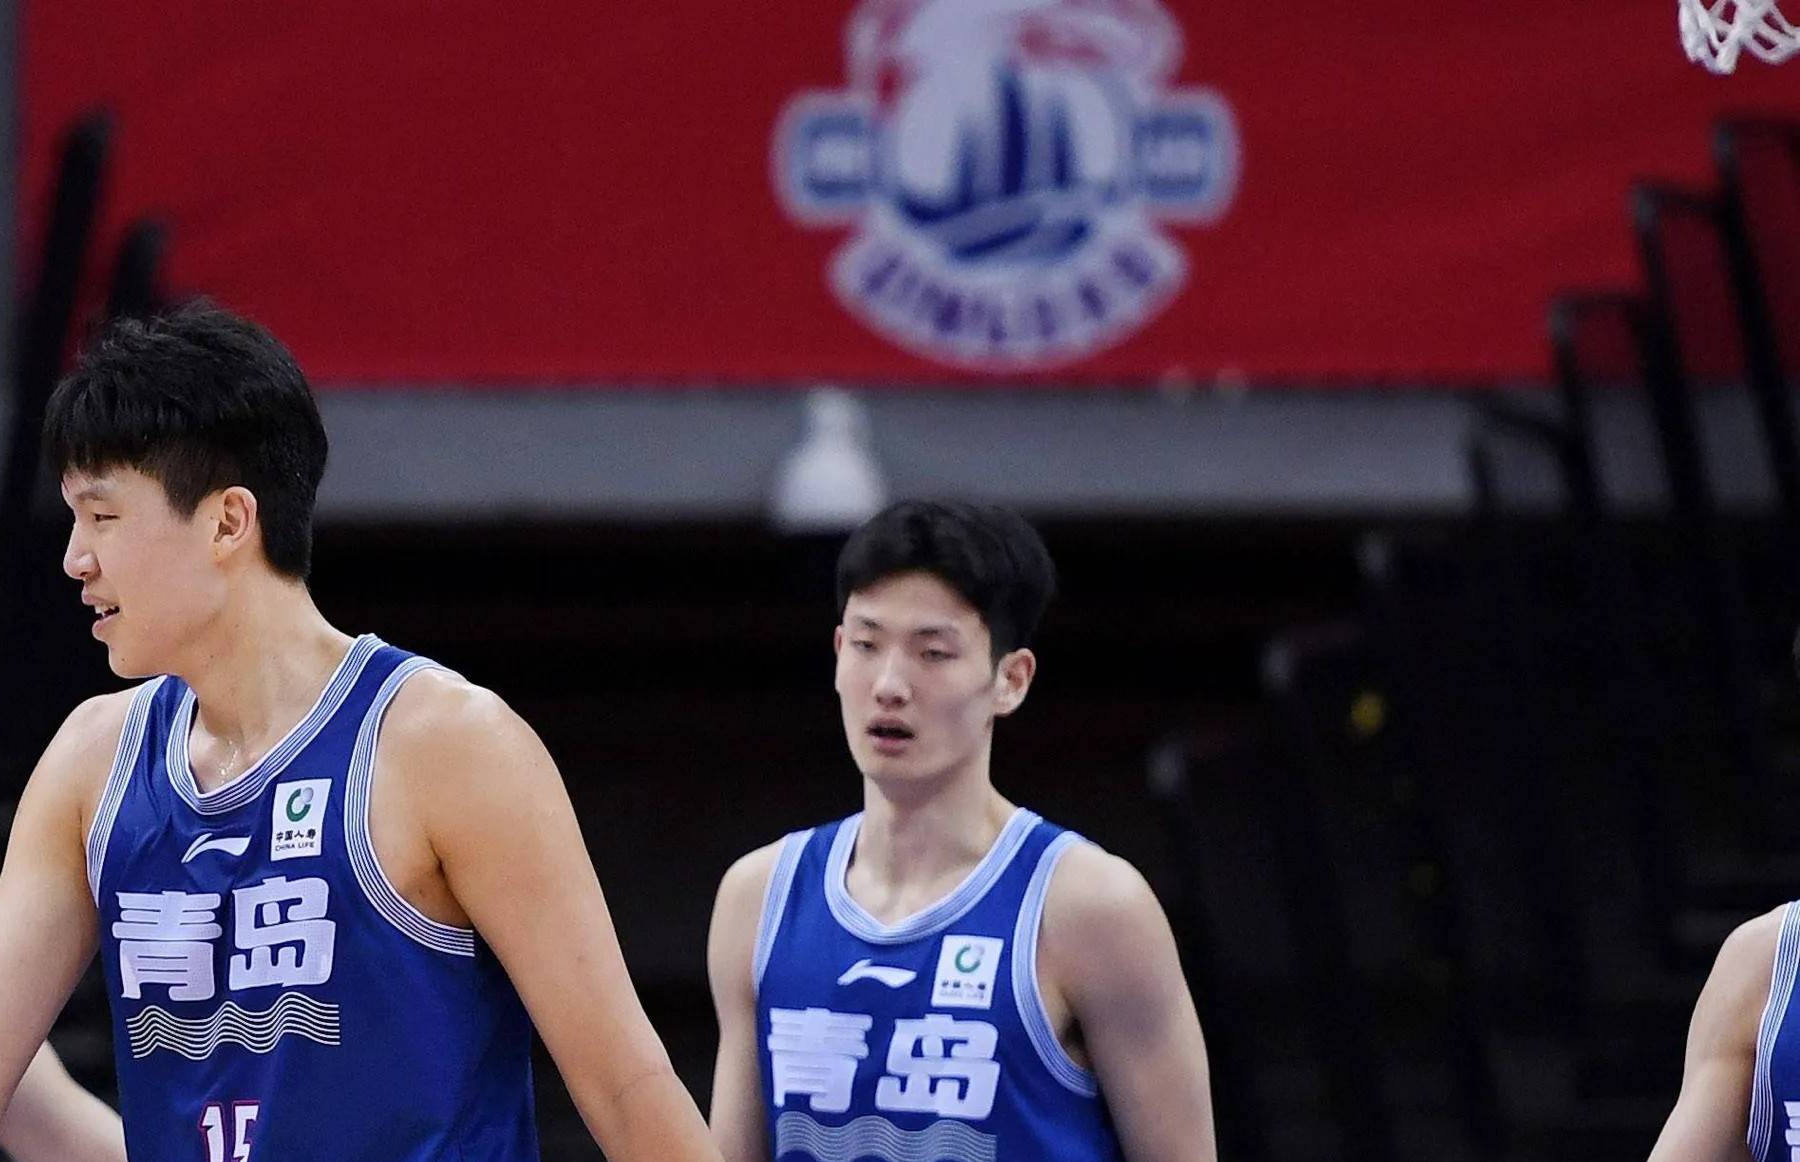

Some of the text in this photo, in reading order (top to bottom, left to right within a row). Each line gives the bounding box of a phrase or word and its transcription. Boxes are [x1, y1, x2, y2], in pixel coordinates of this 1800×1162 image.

[275, 841, 315, 852] CHINA LIFE
[112, 875, 337, 1001] 青岛
[767, 1006, 1001, 1120] 青岛
